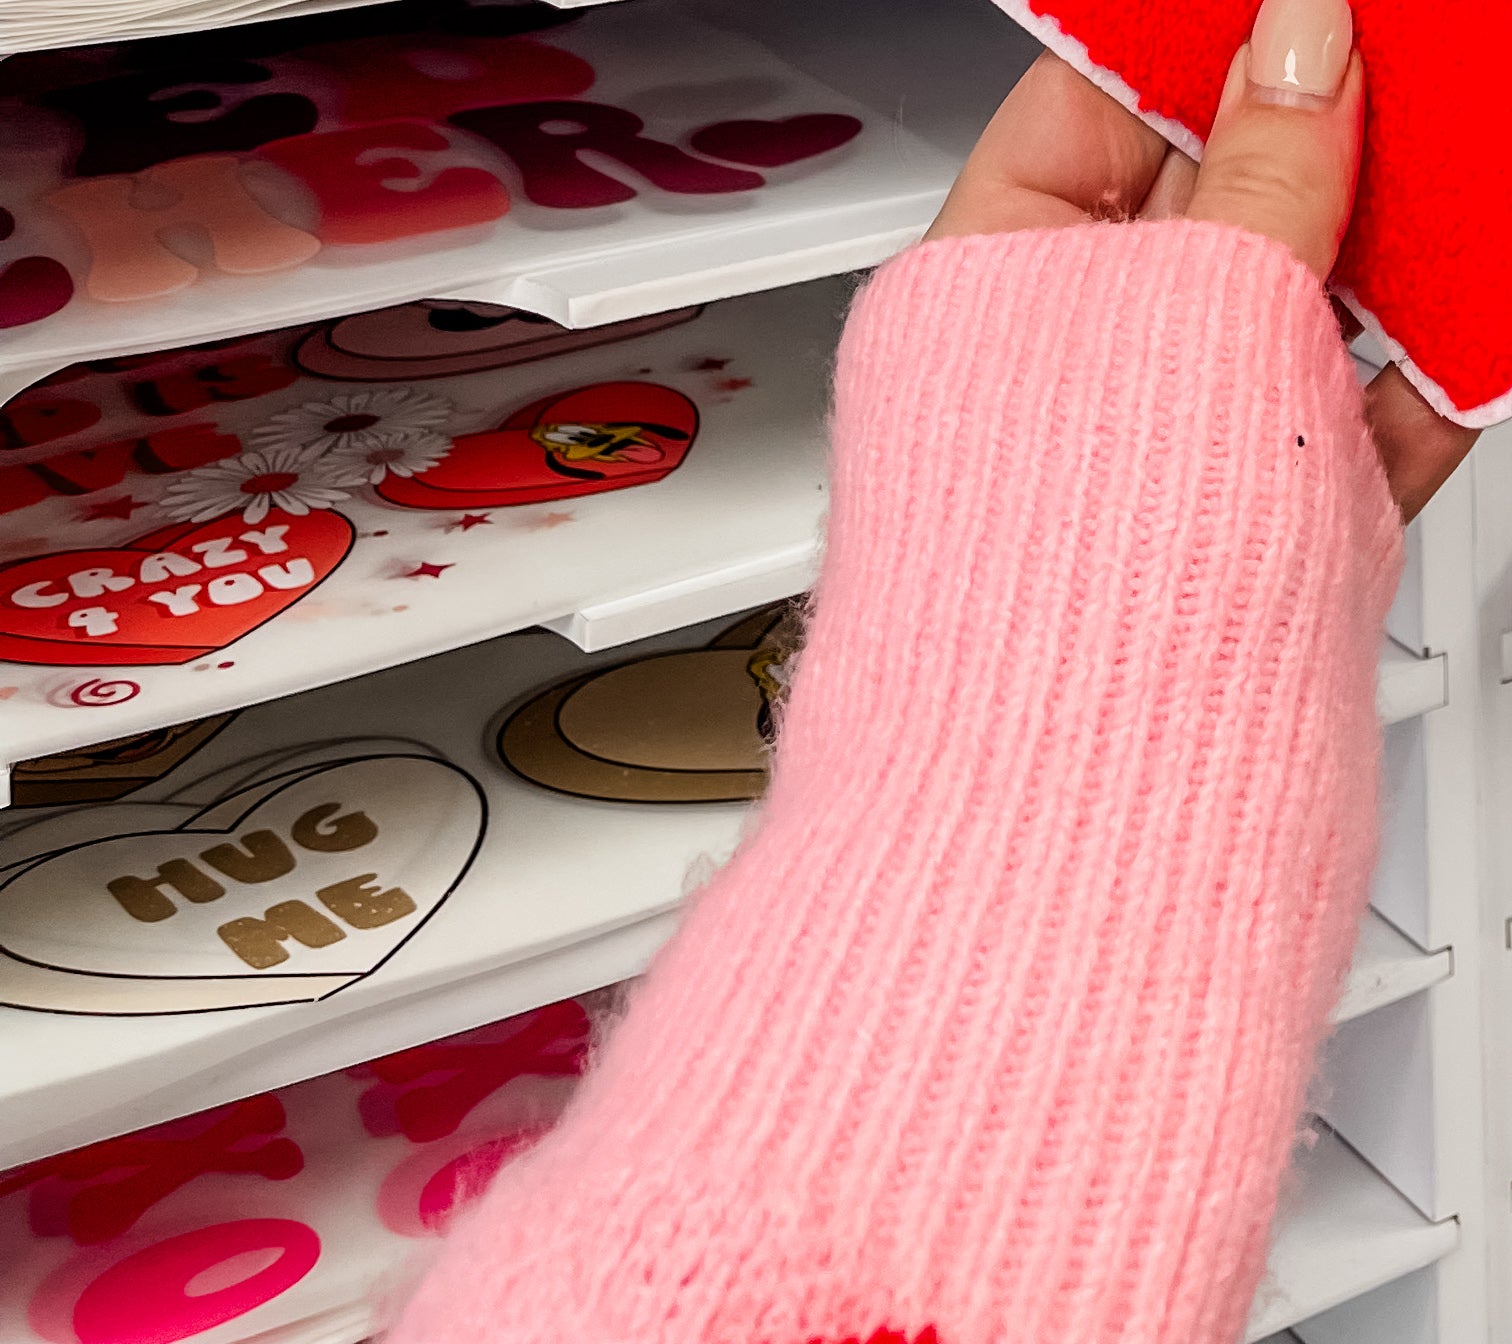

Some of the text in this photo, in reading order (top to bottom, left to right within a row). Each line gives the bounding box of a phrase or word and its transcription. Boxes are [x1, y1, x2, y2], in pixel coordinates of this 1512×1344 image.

[11, 524, 290, 609] CRAZY
[68, 558, 316, 638] 4 YOU
[106, 802, 379, 924] HUG
[217, 872, 418, 971] ME
